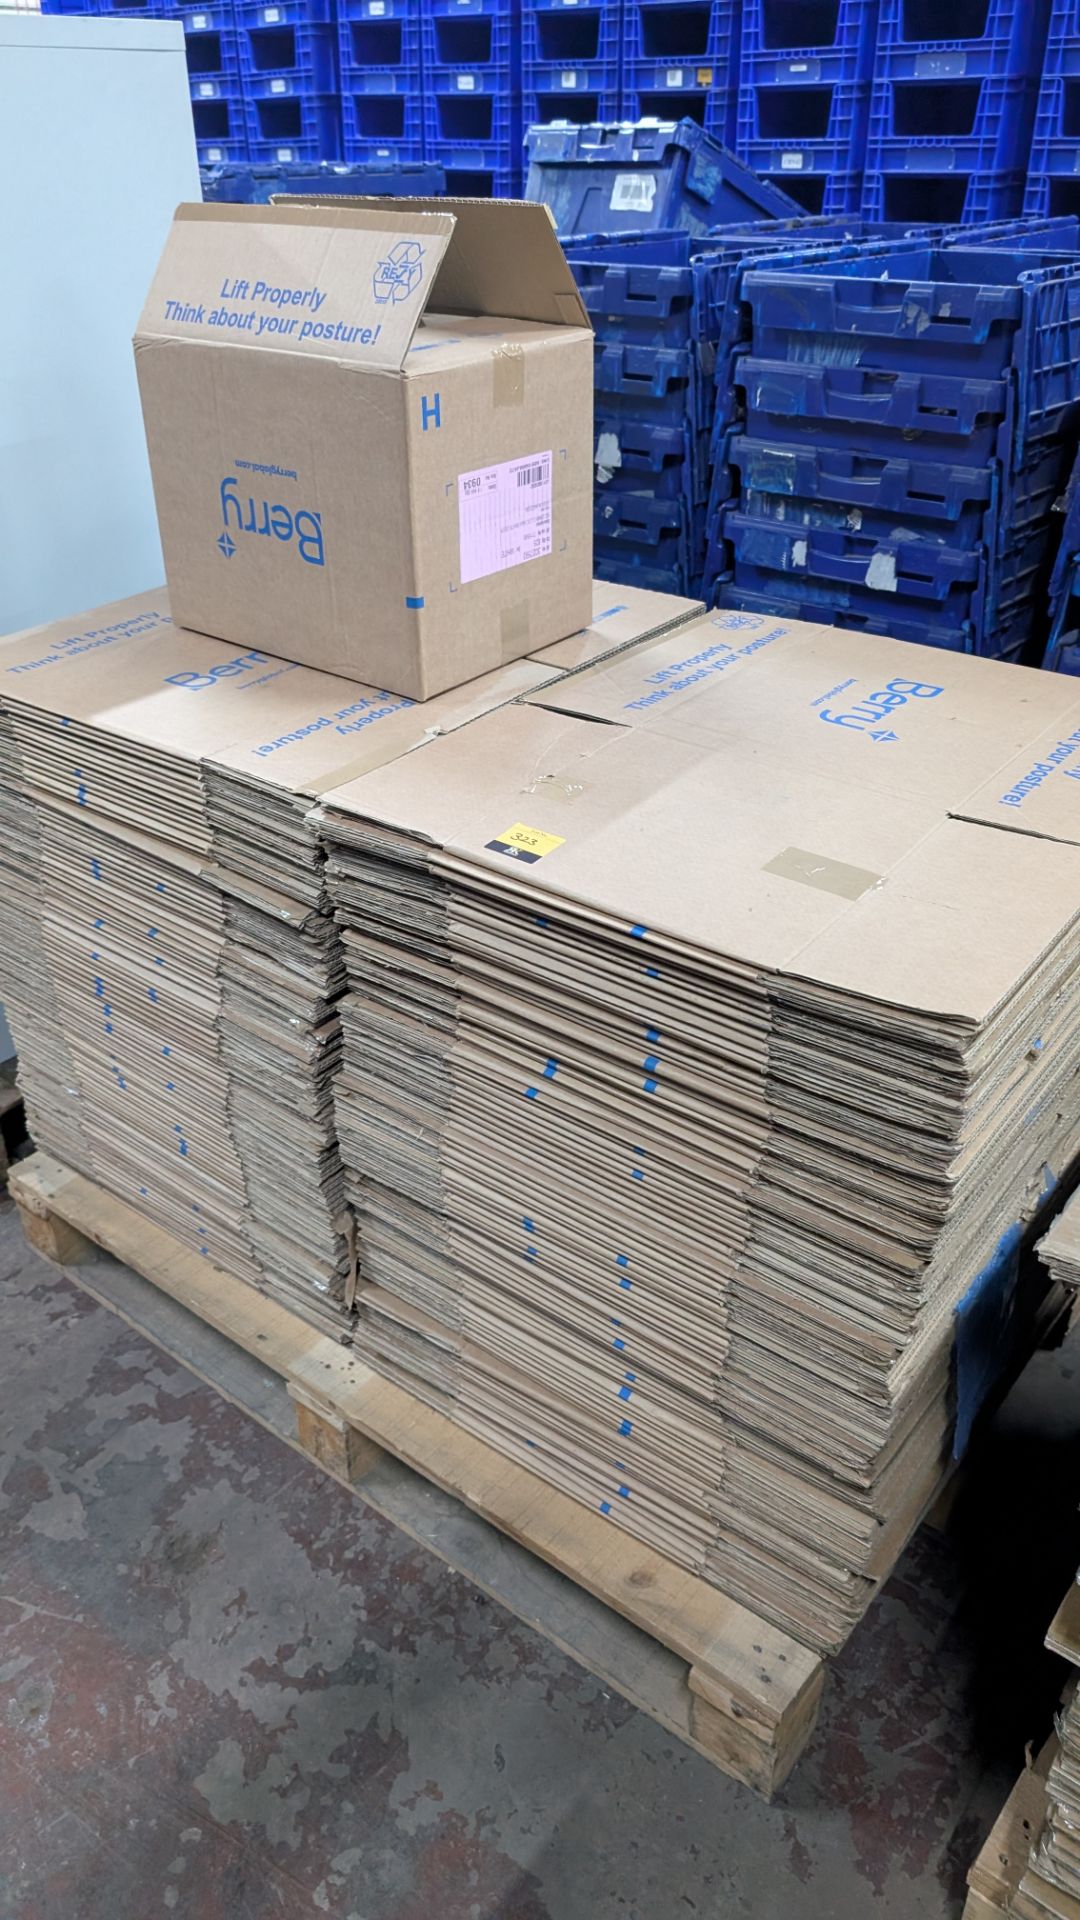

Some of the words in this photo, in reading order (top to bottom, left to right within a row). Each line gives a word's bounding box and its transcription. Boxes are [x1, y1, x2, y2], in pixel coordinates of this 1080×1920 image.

[220, 278, 249, 300] Lift
[251, 281, 327, 313] Properly
[165, 301, 206, 324] Think
[207, 307, 257, 330] about
[255, 314, 299, 336] your
[299, 320, 382, 346] posture!
[421, 393, 441, 431] H
[235, 459, 298, 481] berryglobal.com
[220, 477, 325, 566] Berry
[6, 654, 64, 674] Think
[65, 635, 118, 656] about
[118, 622, 158, 639] your
[50, 636, 86, 650] Lift
[84, 611, 160, 638] Properly
[163, 651, 269, 691] Berr
[623, 688, 673, 711] Think
[668, 669, 713, 691] about
[709, 653, 742, 671] your
[737, 627, 791, 656] posture!
[643, 667, 678, 684] Lift
[671, 642, 733, 675] Properly
[333, 698, 377, 720] your
[335, 698, 417, 736] Properly
[819, 677, 944, 731] Berry
[251, 717, 333, 757] posture!
[1046, 741, 1079, 765] your
[998, 762, 1056, 808] posture!
[510, 832, 538, 846] 323
